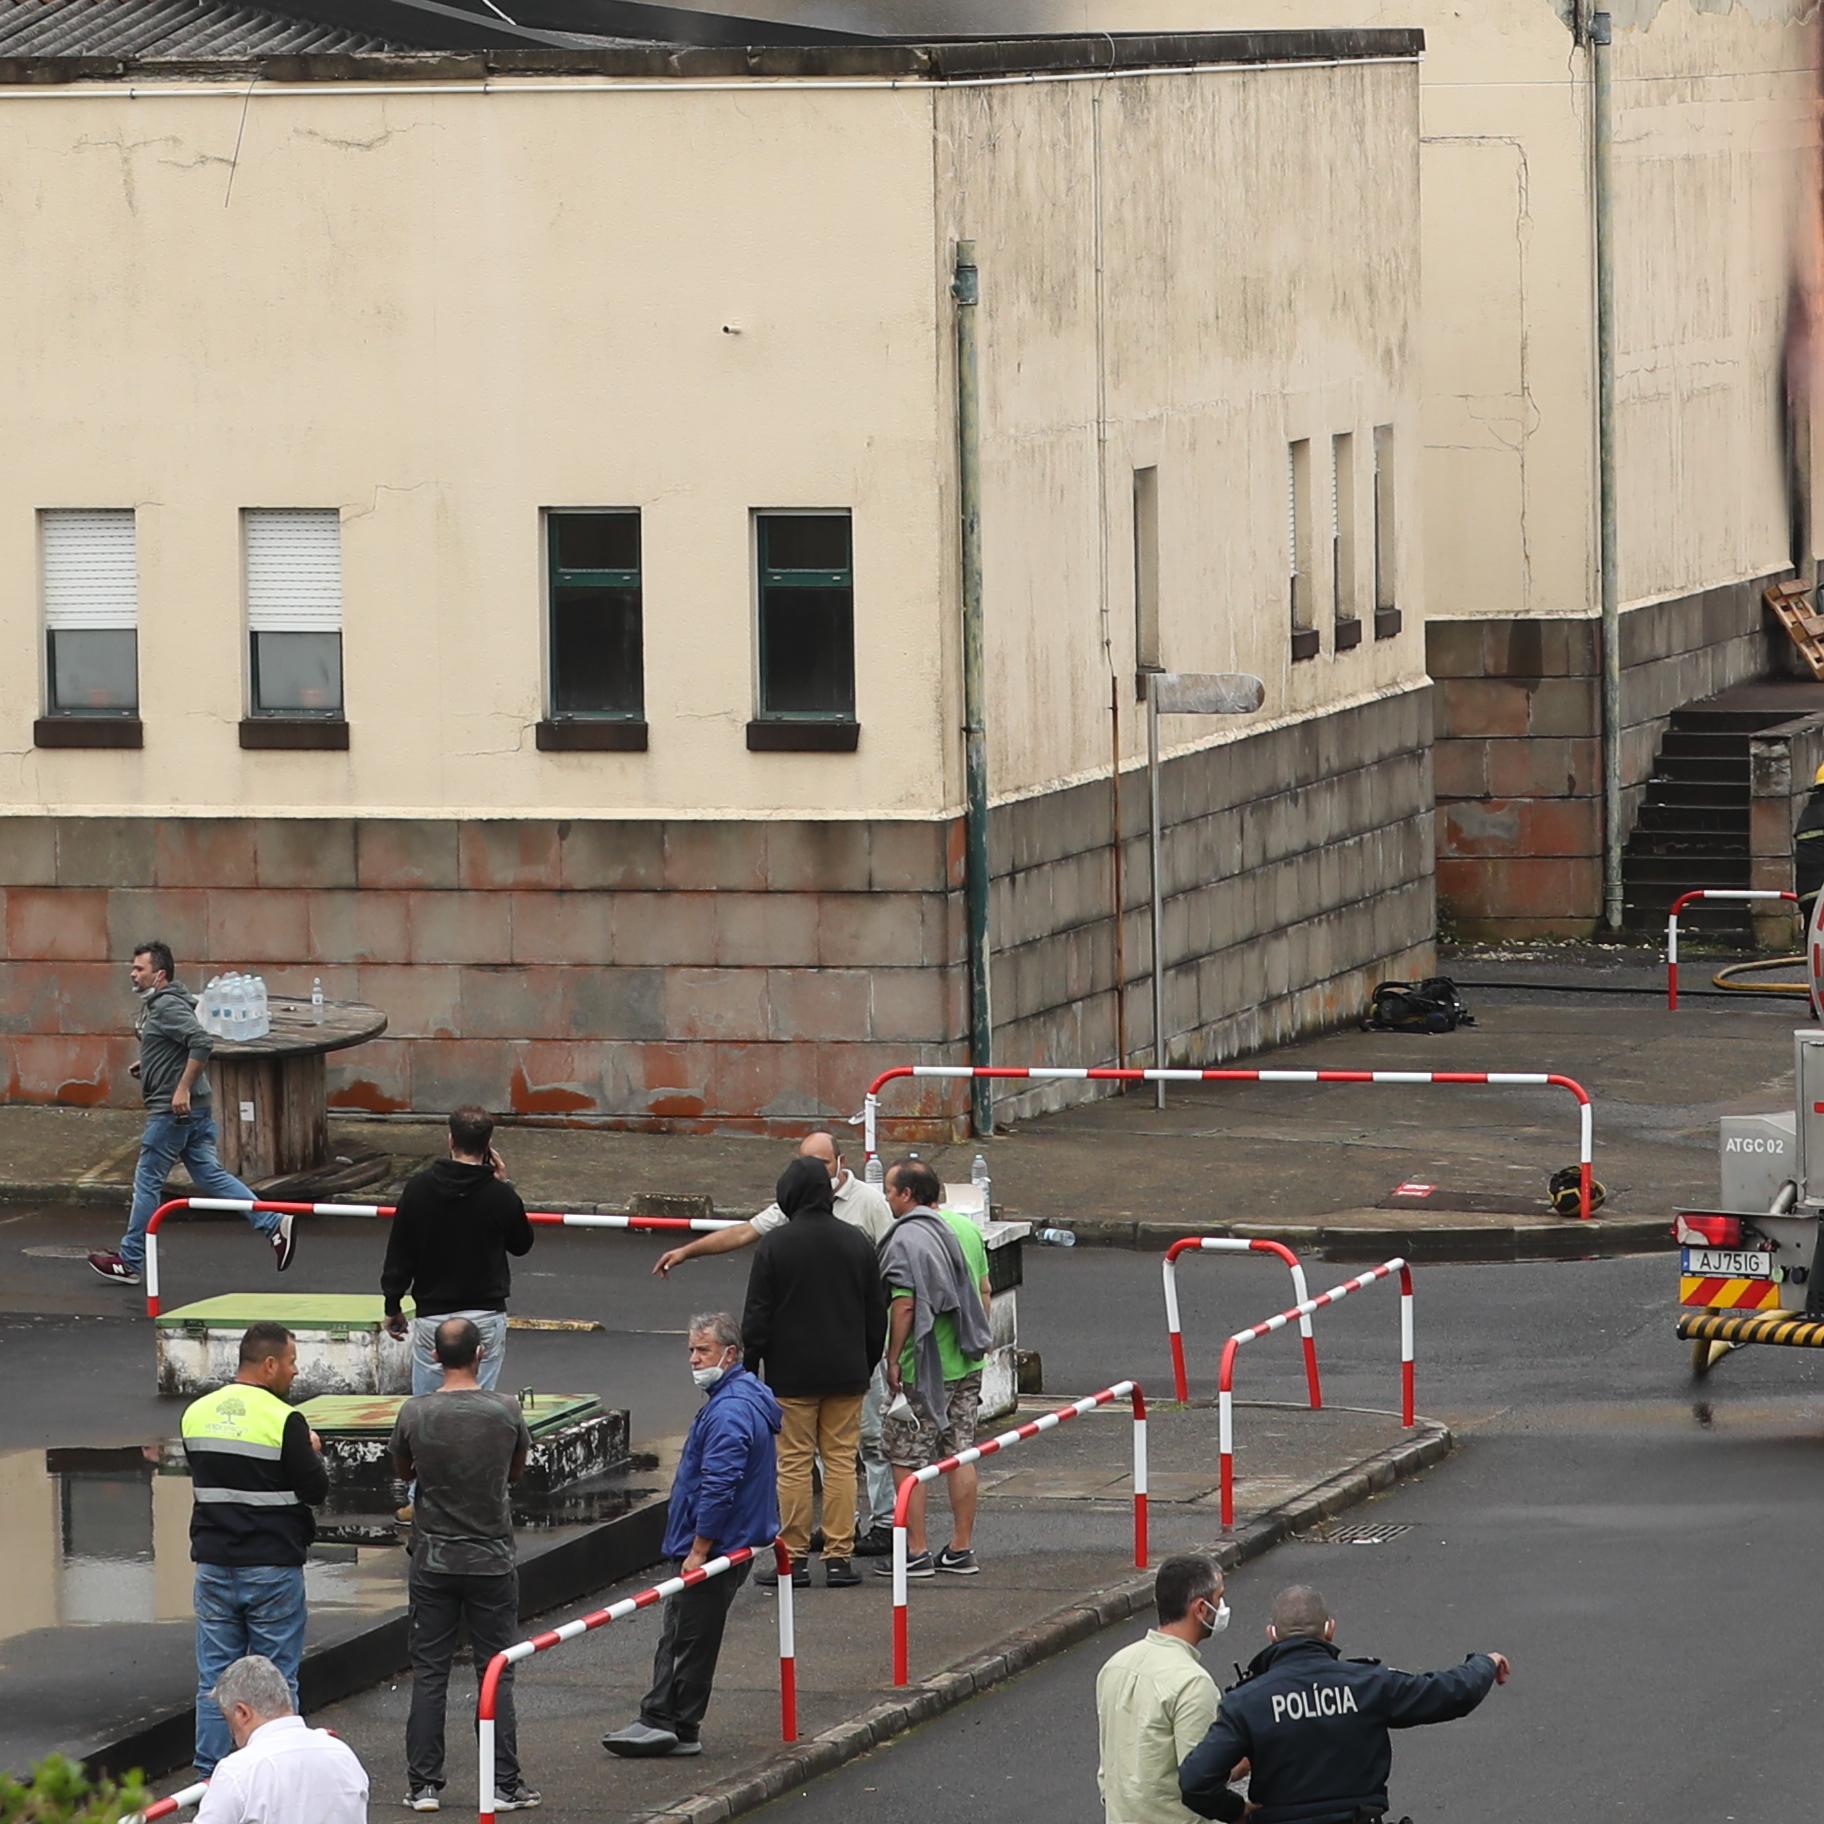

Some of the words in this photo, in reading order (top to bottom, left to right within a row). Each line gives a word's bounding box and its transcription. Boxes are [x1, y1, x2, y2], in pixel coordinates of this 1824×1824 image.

[1726, 1137, 1764, 1153] ATGC
[1767, 1139, 1784, 1154] 02
[1271, 1682, 1358, 1723] POLÍCIA
